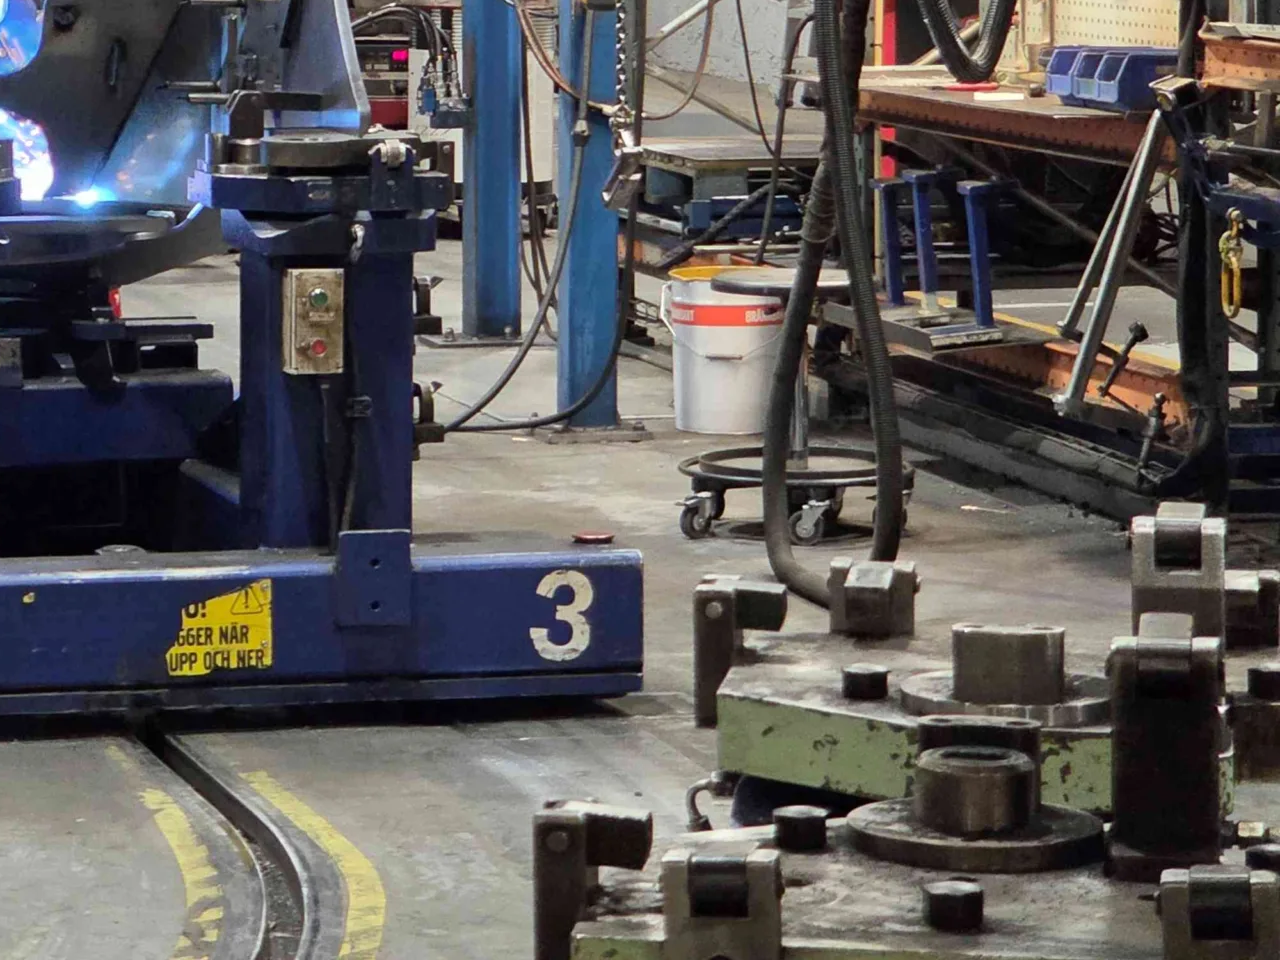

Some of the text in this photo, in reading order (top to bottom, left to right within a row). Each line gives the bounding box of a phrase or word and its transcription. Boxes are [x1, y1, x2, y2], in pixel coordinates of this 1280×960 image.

[529, 569, 594, 662] 3
[218, 622, 249, 644] NÄR
[169, 651, 198, 672] UPP
[203, 649, 230, 670] OCH
